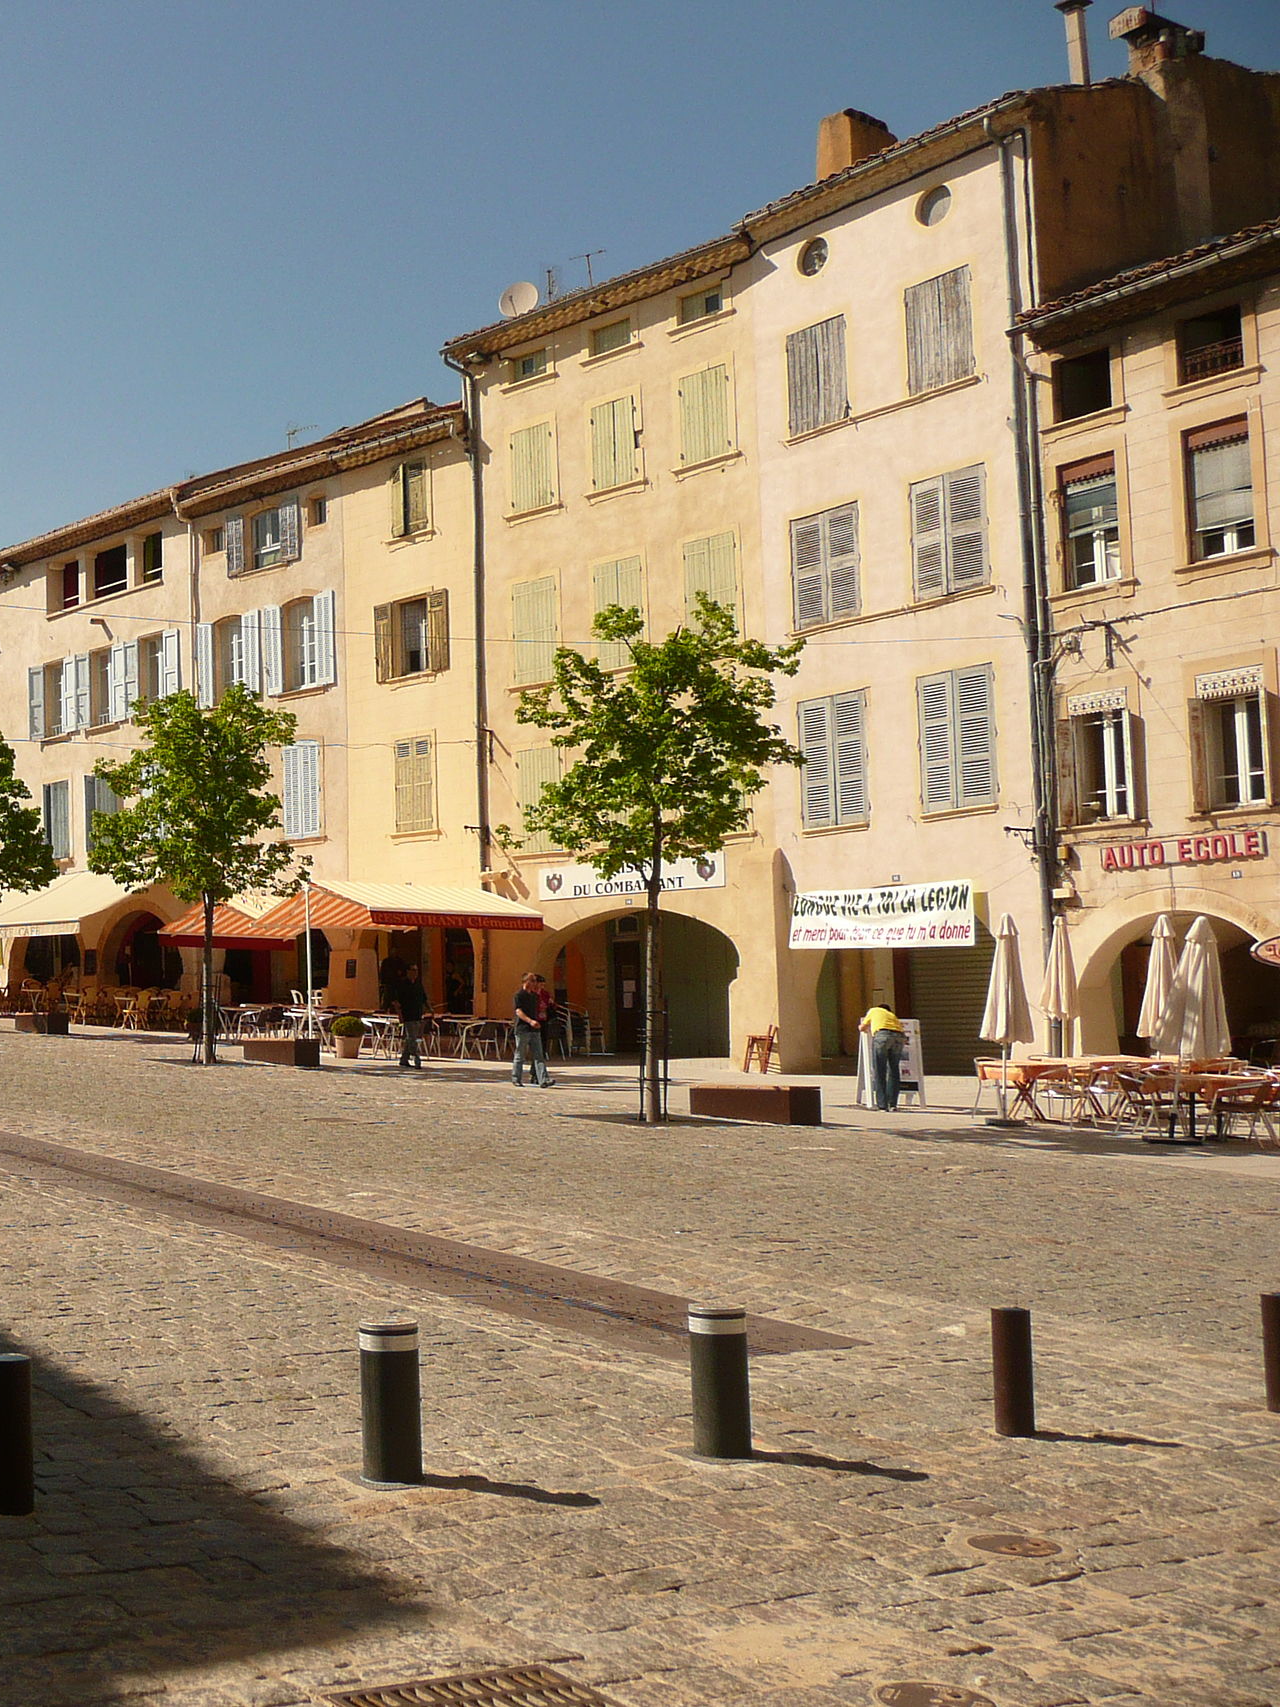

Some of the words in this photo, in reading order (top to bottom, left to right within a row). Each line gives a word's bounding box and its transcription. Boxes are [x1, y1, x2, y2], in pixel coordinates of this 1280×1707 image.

[1104, 842, 1164, 870] AUTO
[1178, 831, 1260, 862] ECOLE
[573, 884, 591, 896] DU
[595, 876, 684, 894] COMBATANT
[862, 893, 873, 915] A
[877, 890, 899, 914] TOI
[921, 885, 969, 912] LEGION
[372, 911, 465, 926] RESTAURANT
[468, 916, 542, 930] Clémentine
[792, 926, 803, 942] et
[803, 922, 828, 942] merci
[885, 927, 905, 945] que
[917, 920, 937, 940] m'a
[939, 919, 971, 940] donné
